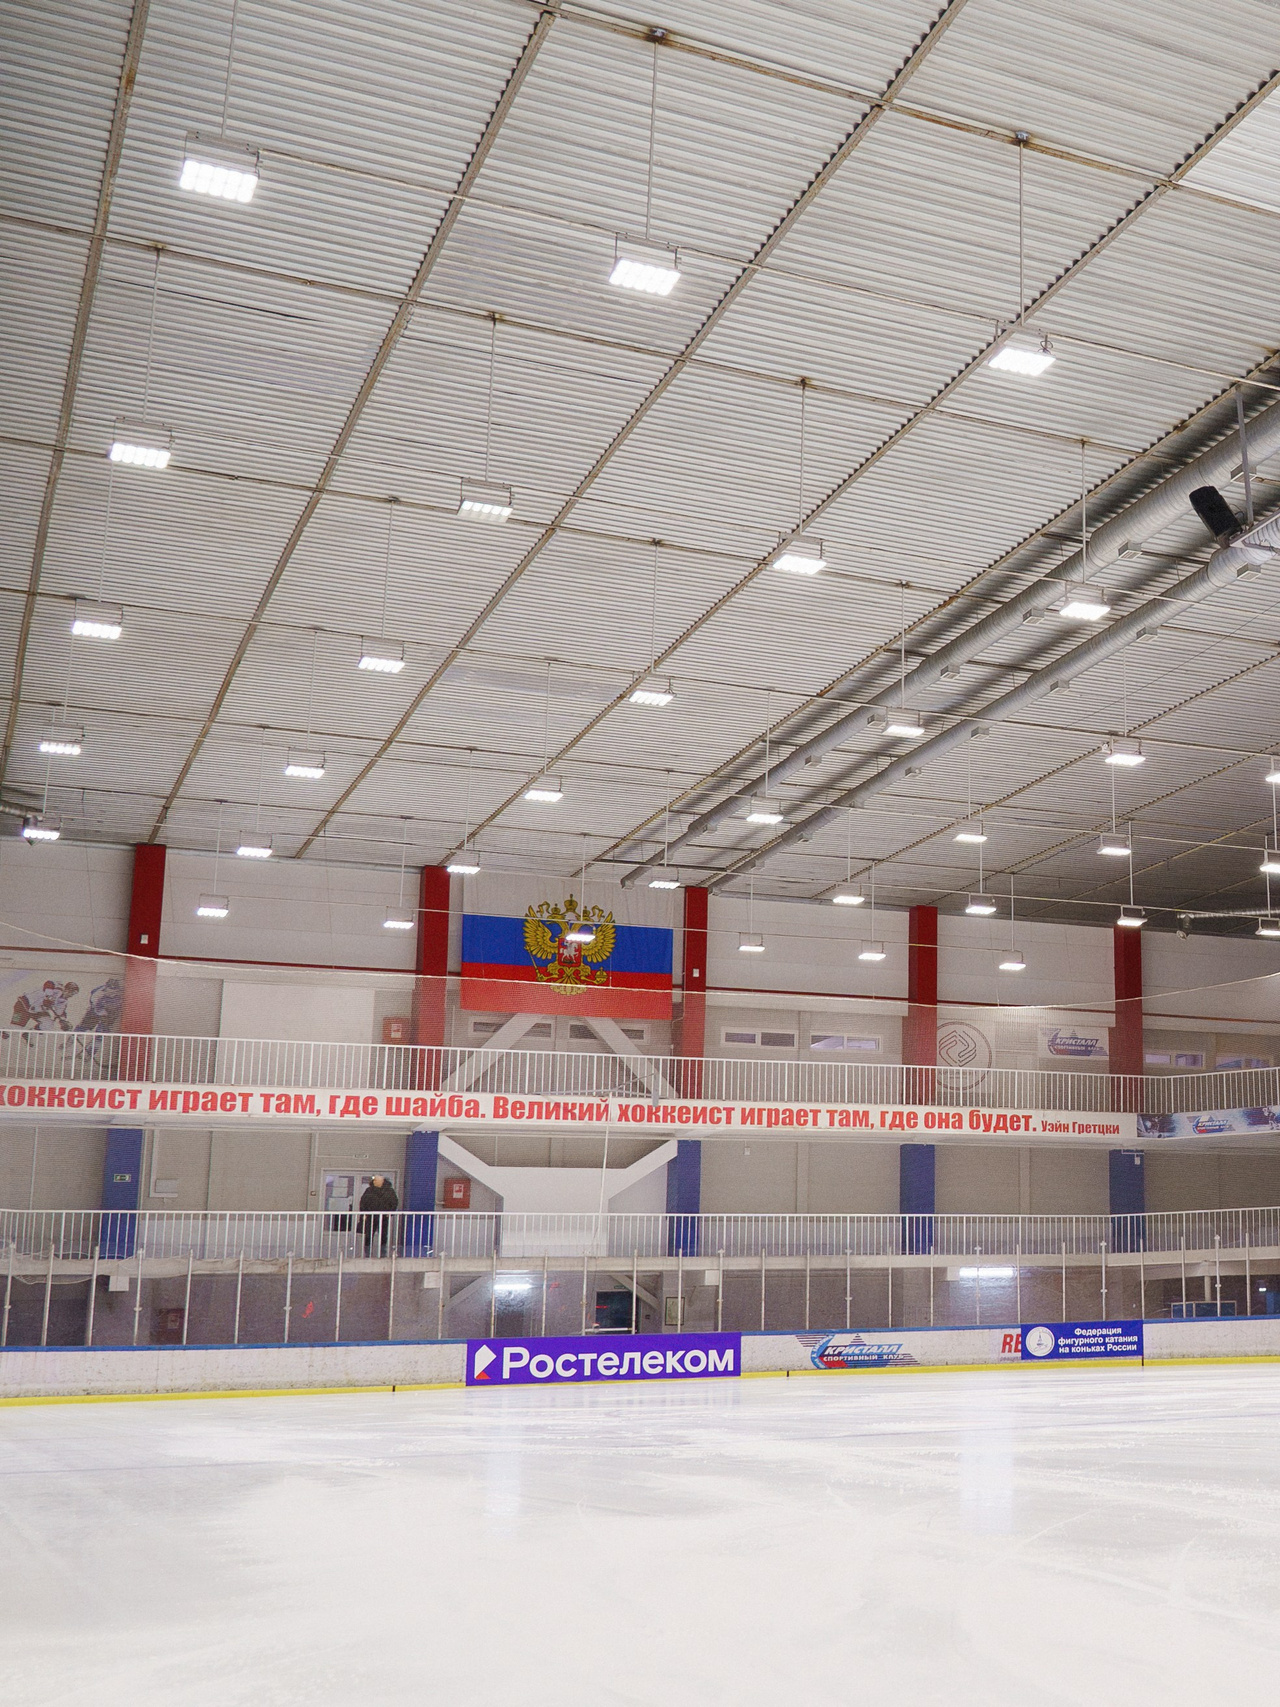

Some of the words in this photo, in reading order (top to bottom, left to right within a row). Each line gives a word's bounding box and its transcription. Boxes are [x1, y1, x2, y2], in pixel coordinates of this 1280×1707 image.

[149, 1090, 253, 1114] играет
[260, 1093, 322, 1117] там,
[328, 1095, 378, 1118] где
[385, 1092, 486, 1119] шайба.
[493, 1096, 610, 1122] Великий
[617, 1103, 735, 1125] хоккеист
[741, 1107, 822, 1128] играет
[826, 1109, 875, 1129] там,
[880, 1110, 918, 1131] где
[924, 1111, 963, 1130] она
[969, 1109, 1037, 1134] будет.
[1041, 1120, 1069, 1134] Уэйн
[1072, 1121, 1120, 1136] Гретцки
[1074, 1327, 1122, 1337] Федерация
[1058, 1337, 1104, 1346] фигурного
[1105, 1335, 1138, 1343] катания
[824, 1345, 900, 1355] КРИСТАЛЛ
[1071, 1345, 1105, 1353] коньках
[1107, 1343, 1137, 1351] России
[823, 1353, 878, 1362] СПОРТИВНЫЙ
[502, 1346, 734, 1380] Ростелеком
